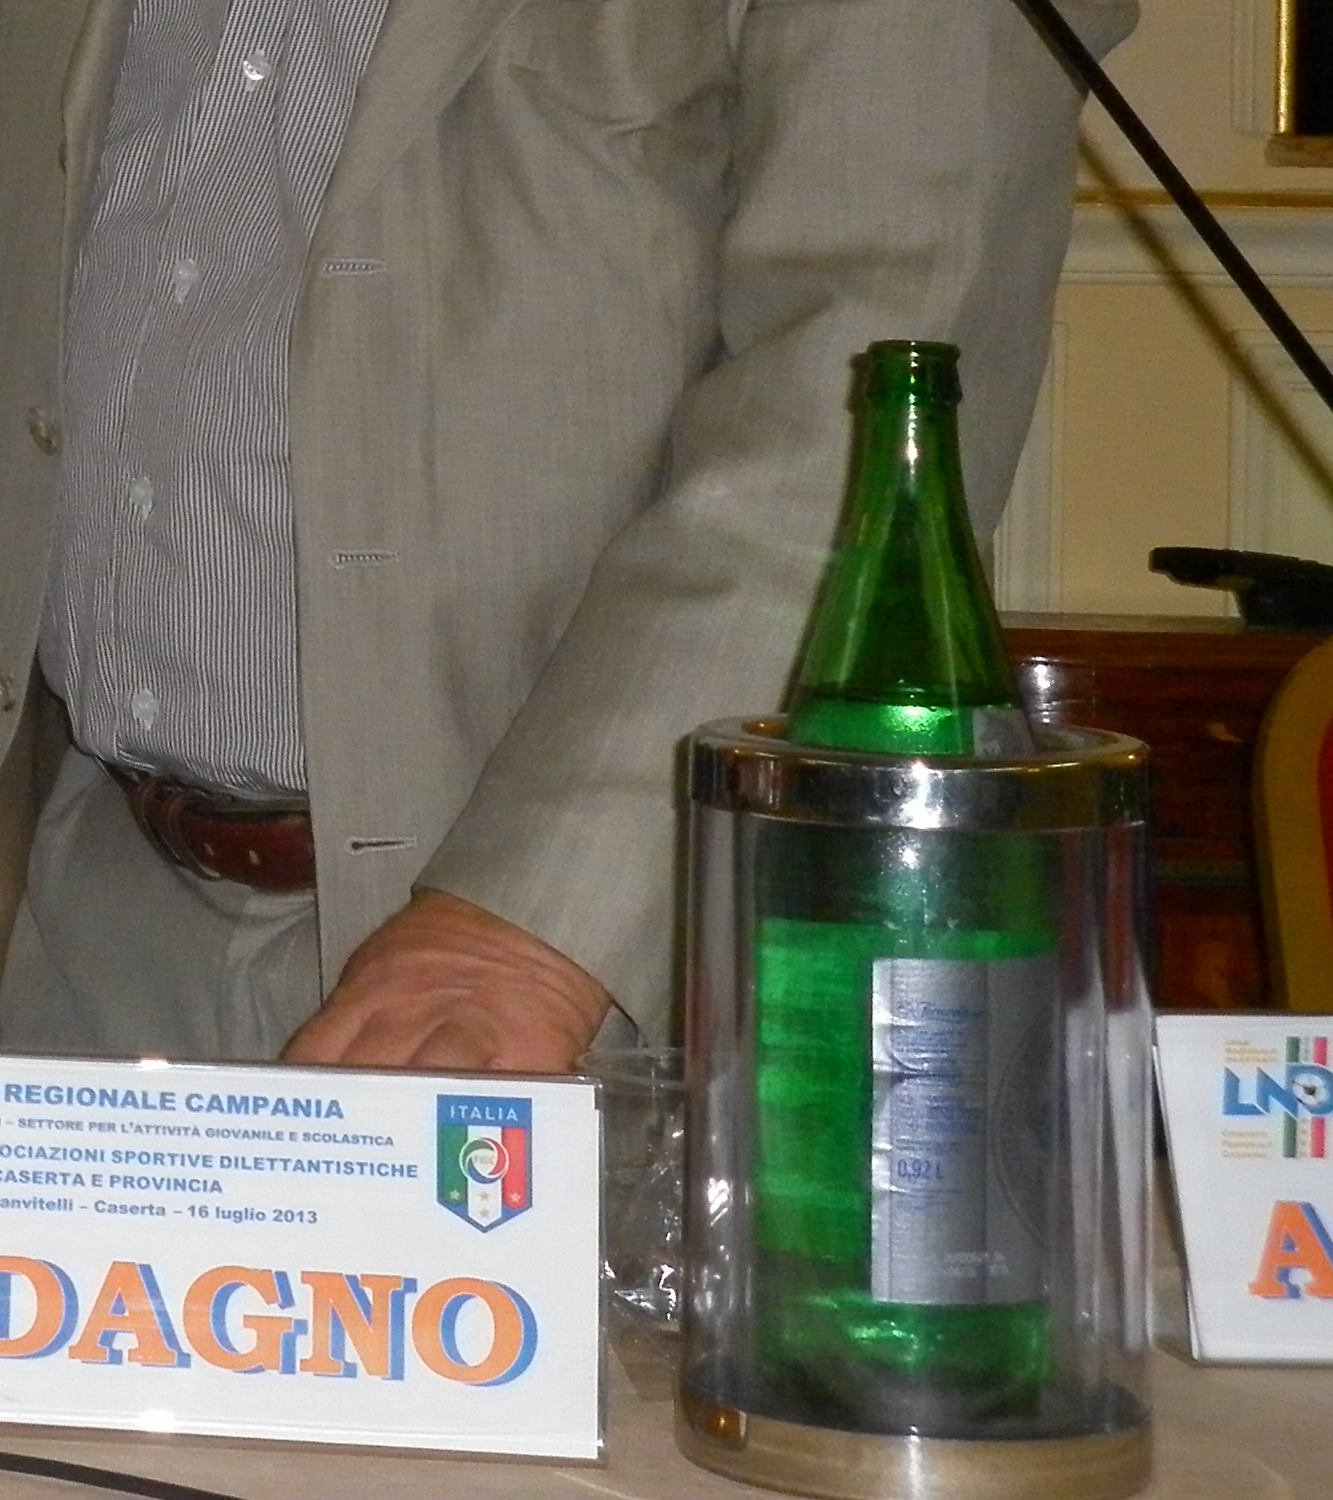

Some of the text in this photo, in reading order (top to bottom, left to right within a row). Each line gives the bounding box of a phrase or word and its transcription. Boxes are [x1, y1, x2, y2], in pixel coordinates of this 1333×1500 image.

[3, 1083, 177, 1112] REGIONALE
[184, 1092, 344, 1120] CAMPANIA
[449, 1105, 519, 1121] ITALIA
[17, 1118, 83, 1131] SETTORE
[88, 1121, 116, 1133] PER
[120, 1121, 201, 1138] L'ATTIVITÀ
[205, 1127, 285, 1141] GIOVANILE
[288, 1131, 298, 1142] E
[302, 1131, 394, 1147] SCOLASTICA
[110, 1149, 214, 1169] SPORTIVE
[219, 1155, 419, 1178] DILETTANTISTICHE
[91, 1173, 104, 1187] E
[109, 1174, 223, 1194] PROVINCIA
[93, 1200, 166, 1216] Caserta
[186, 1205, 209, 1219] 16
[215, 1206, 266, 1223] luglio
[272, 1208, 318, 1224] 2013
